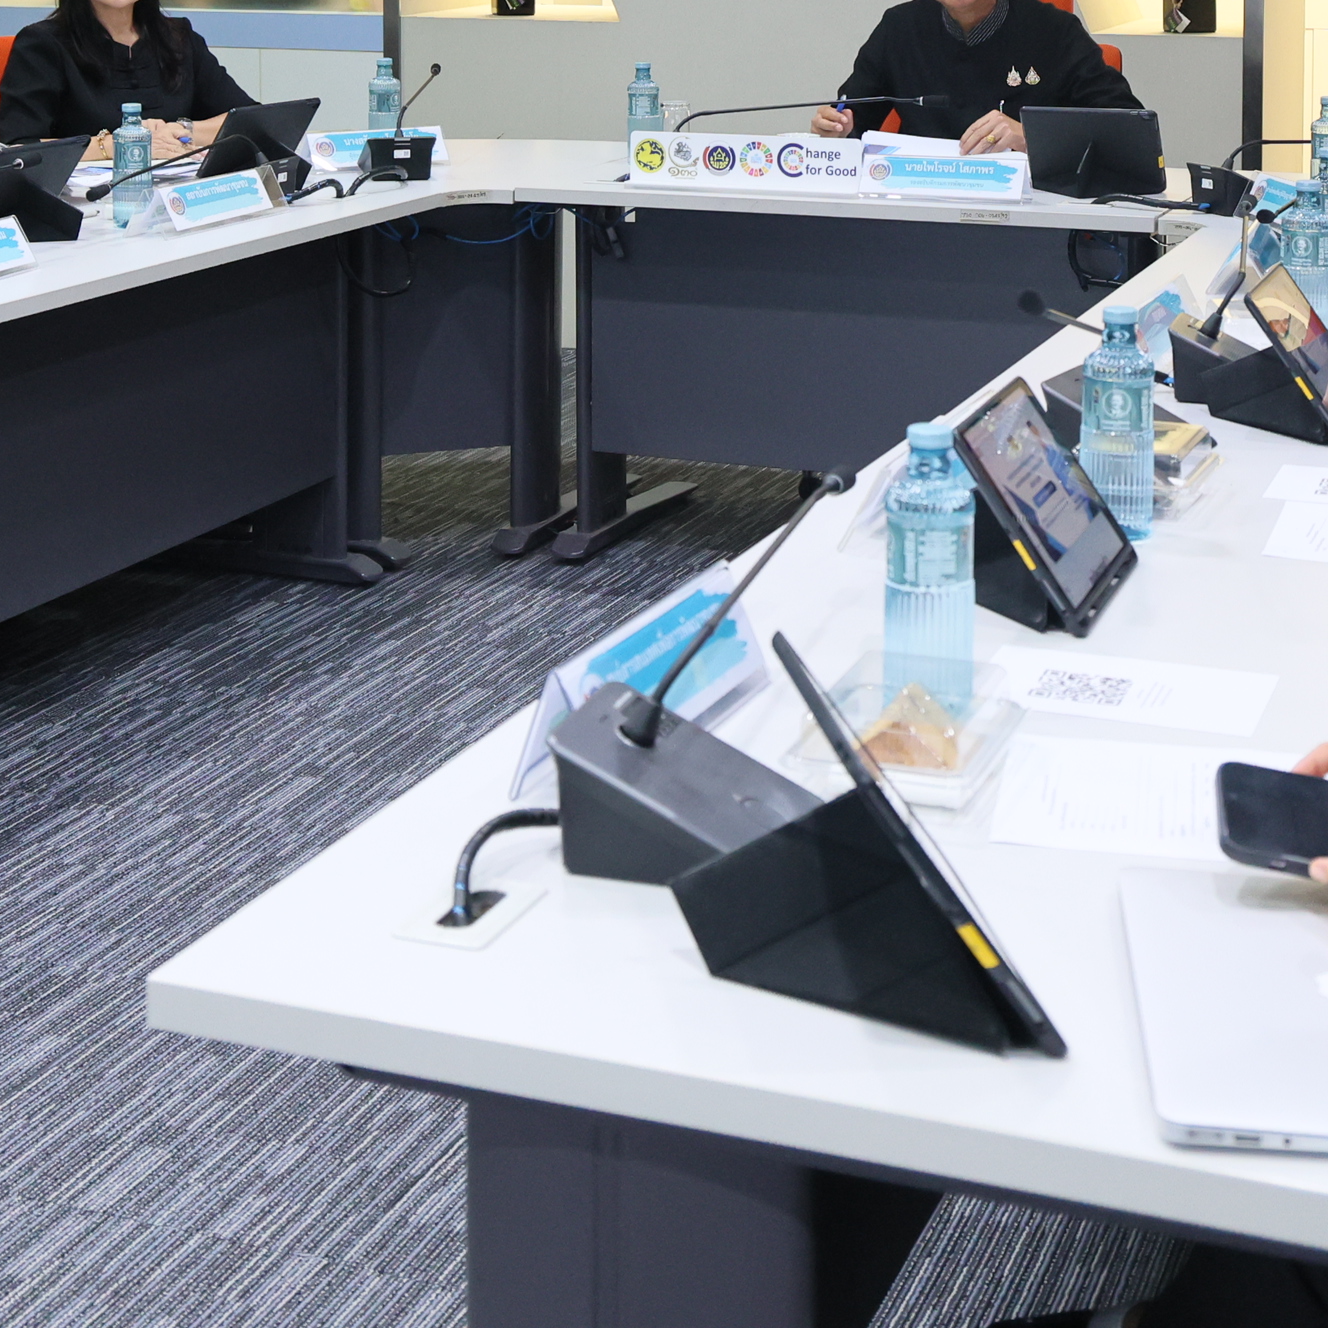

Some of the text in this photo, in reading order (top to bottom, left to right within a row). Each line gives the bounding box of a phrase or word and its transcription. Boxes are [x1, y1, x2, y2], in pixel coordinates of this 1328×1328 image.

[805, 165, 857, 177] for Good
[904, 160, 995, 175] นายไพโรจน์ โสภาพร
